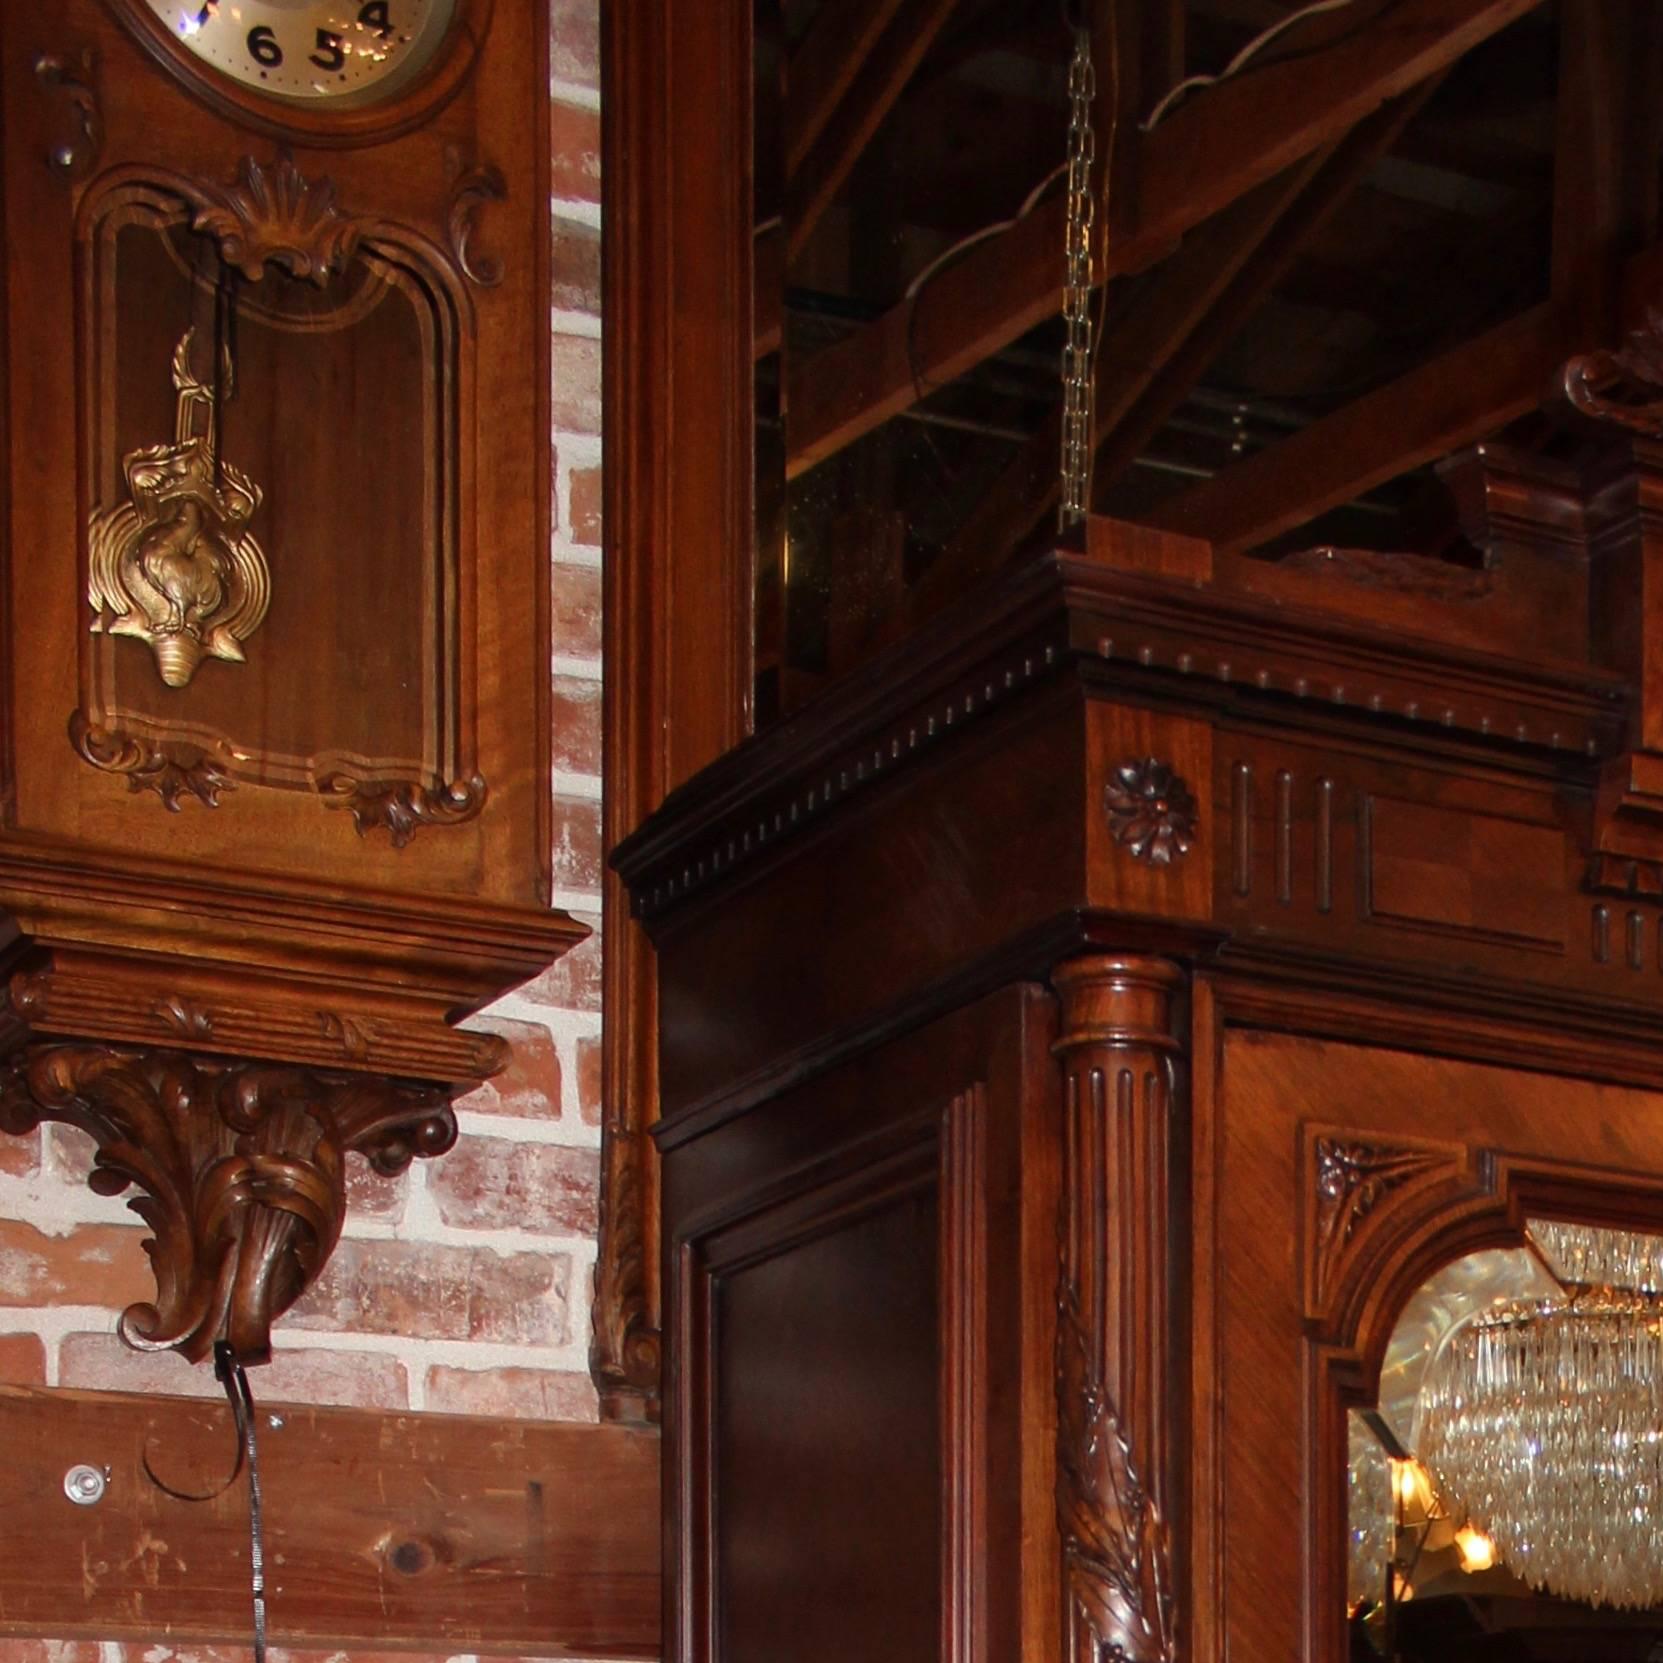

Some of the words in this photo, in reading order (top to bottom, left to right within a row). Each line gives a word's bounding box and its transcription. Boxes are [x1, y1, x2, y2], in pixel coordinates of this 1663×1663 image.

[357, 0, 395, 39] 4
[246, 25, 283, 67] 6
[308, 28, 347, 71] 5
